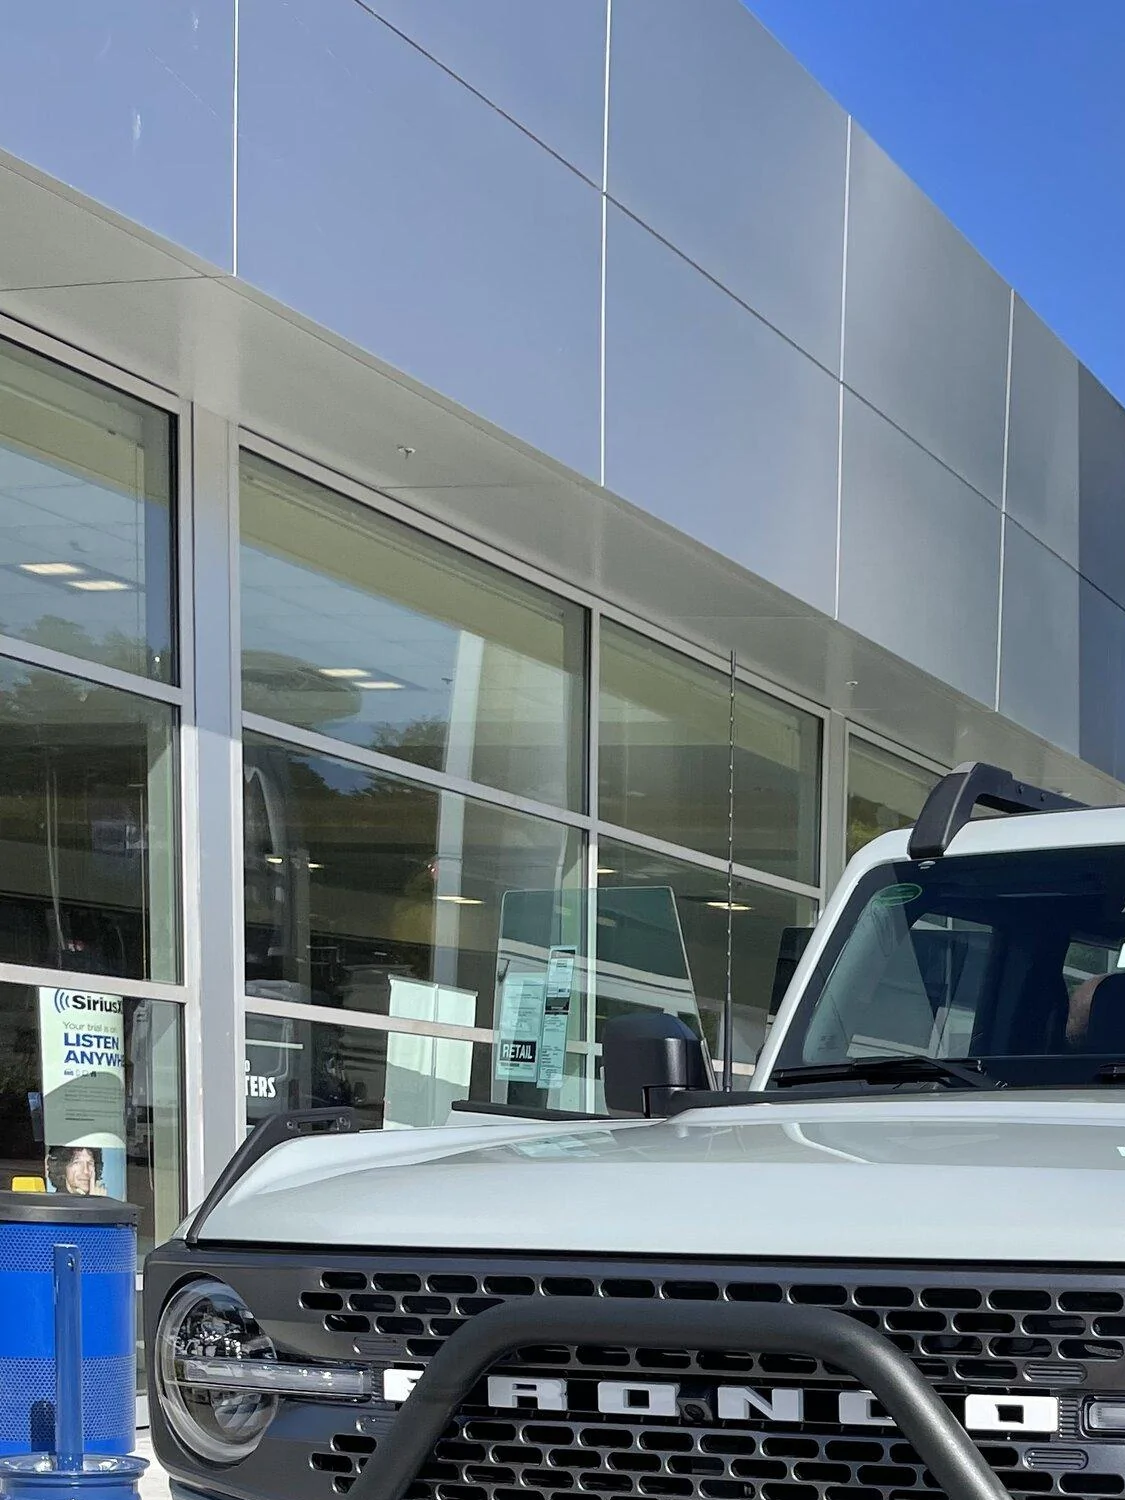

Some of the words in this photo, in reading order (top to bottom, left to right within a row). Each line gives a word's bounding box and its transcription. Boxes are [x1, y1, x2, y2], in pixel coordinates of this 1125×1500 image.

[63, 1021, 85, 1031] Your
[64, 1032, 119, 1050] LISTEN
[502, 1044, 534, 1060] RETAIL
